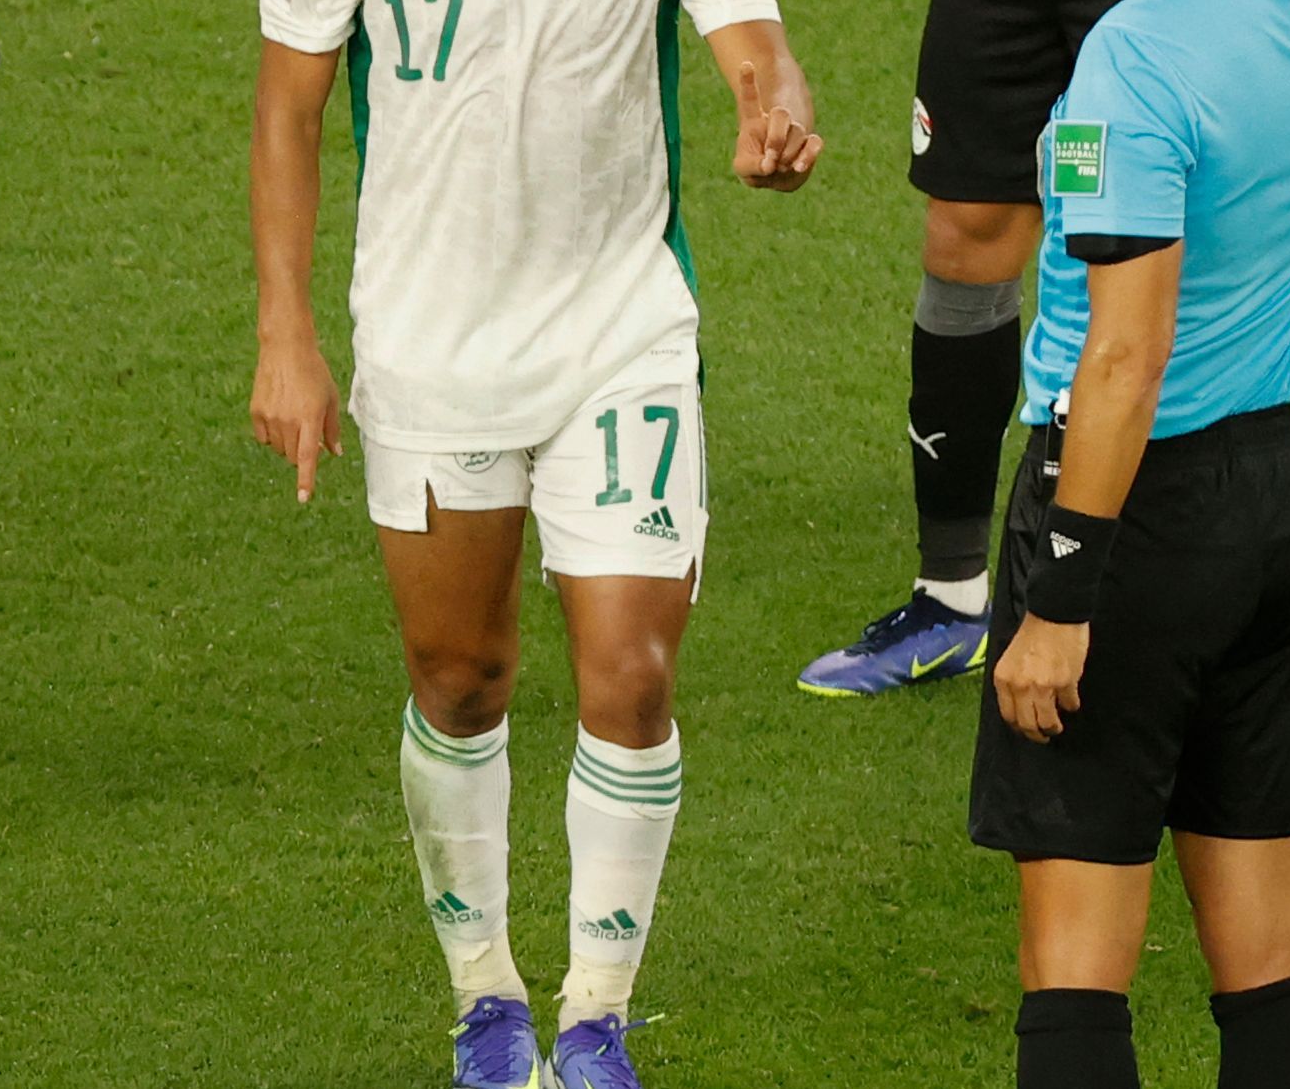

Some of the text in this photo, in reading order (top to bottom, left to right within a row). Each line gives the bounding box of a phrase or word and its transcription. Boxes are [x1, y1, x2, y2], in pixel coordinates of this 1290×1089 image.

[1055, 141, 1099, 151] LIVING
[1055, 150, 1099, 159] FOOTBALL
[1077, 165, 1098, 176] FIFA
[595, 405, 680, 507] 17
[633, 523, 680, 542] adidas
